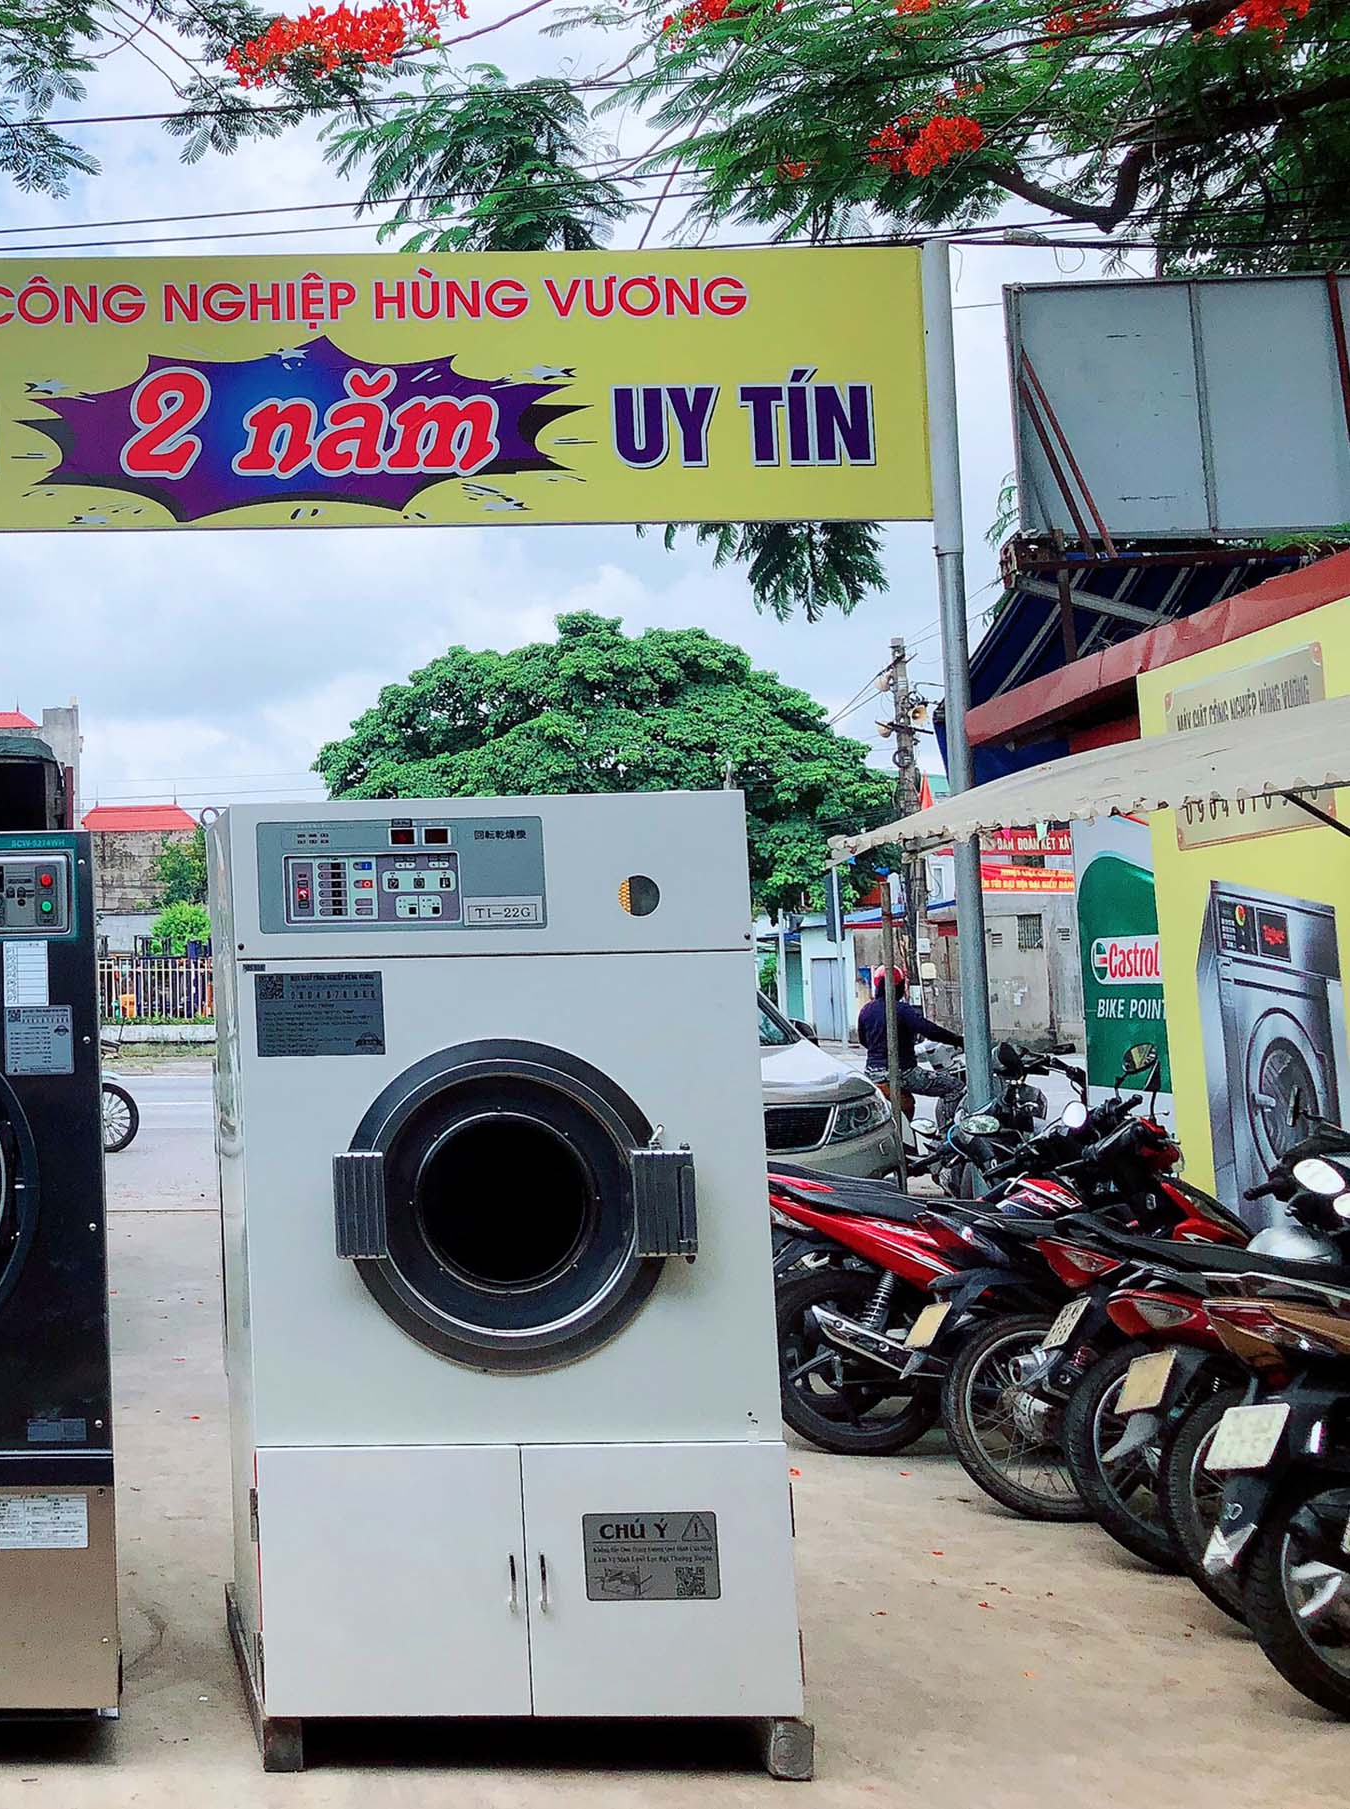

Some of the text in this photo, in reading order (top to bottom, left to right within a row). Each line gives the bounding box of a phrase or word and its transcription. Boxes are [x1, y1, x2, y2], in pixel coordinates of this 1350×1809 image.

[162, 272, 356, 330] NGHIỆP
[374, 267, 529, 321] HÙNG
[544, 275, 748, 319] VƯƠNG
[119, 366, 211, 480] 2
[233, 367, 500, 475] năm
[611, 384, 720, 468] UY
[739, 367, 877, 467] TÍN
[1109, 941, 1160, 978] Castrol
[1097, 998, 1125, 1018] BIKE
[600, 1518, 668, 1540] CHÚ Ý
